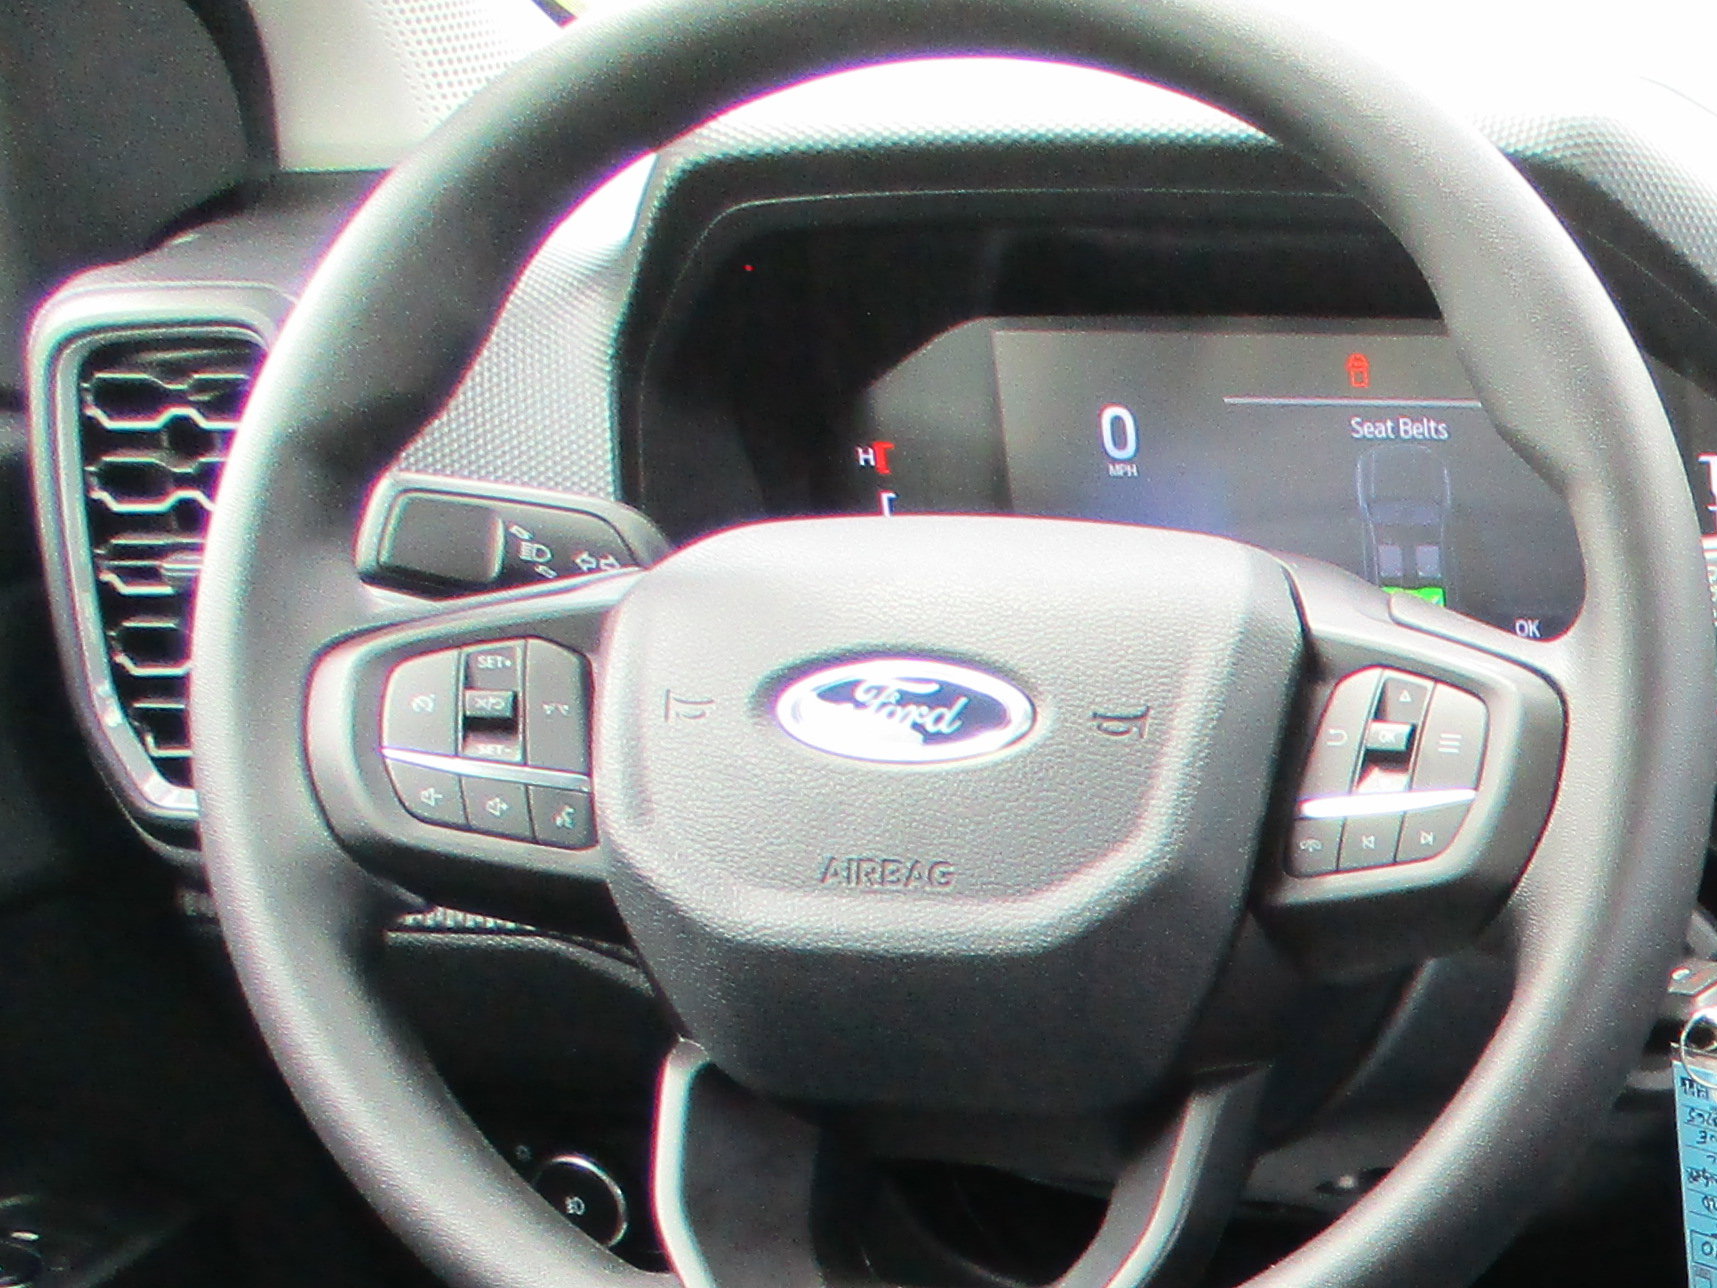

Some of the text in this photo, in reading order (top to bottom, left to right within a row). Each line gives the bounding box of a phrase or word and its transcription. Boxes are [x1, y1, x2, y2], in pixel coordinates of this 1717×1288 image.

[1101, 403, 1138, 460] 0
[1351, 417, 1449, 441] Seat Belts
[856, 446, 876, 467] H
[1108, 463, 1138, 478] MPH
[1515, 619, 1541, 638] OK
[852, 678, 970, 735] Ford
[819, 856, 955, 887] AIRBAG
